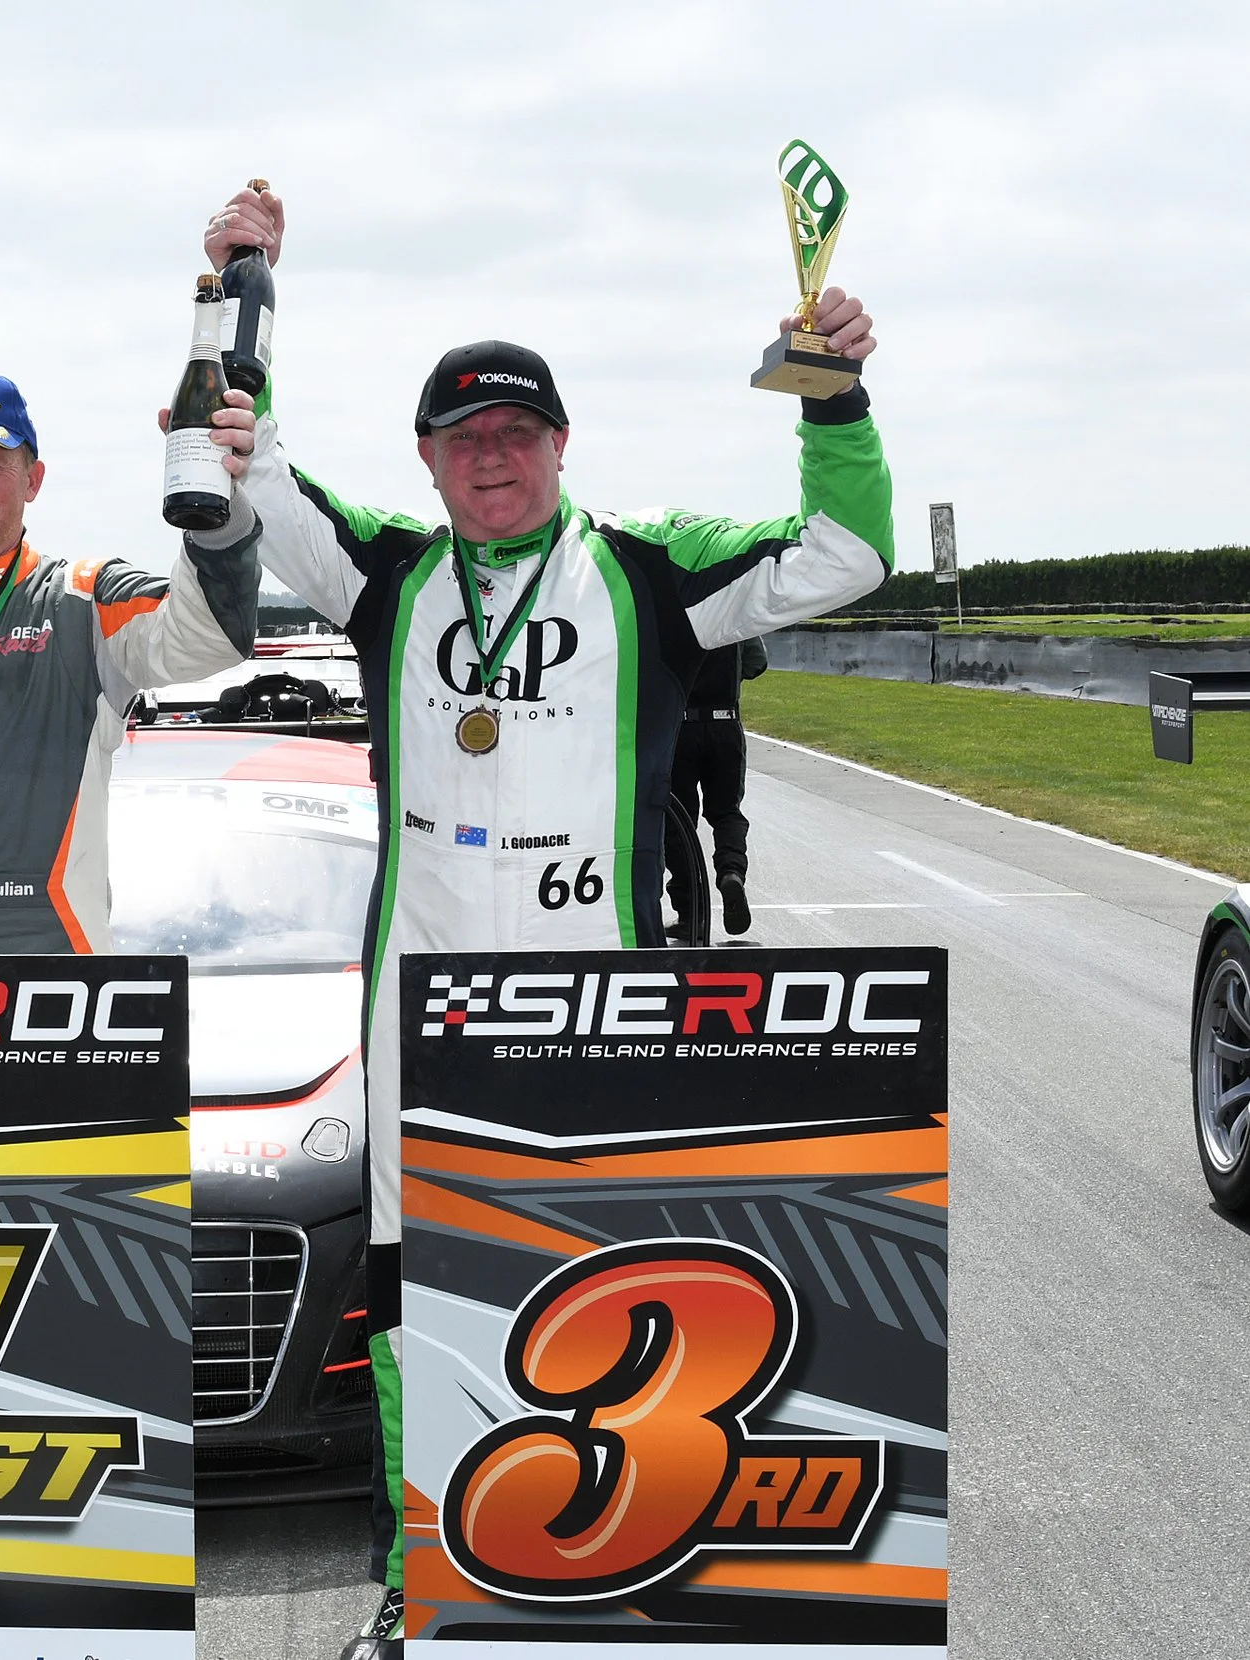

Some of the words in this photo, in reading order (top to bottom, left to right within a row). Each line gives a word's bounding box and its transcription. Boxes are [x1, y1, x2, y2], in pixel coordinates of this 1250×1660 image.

[477, 373, 539, 391] YOKOHAMA
[428, 698, 574, 721] SOLTIONS
[262, 796, 349, 817] OMP
[501, 837, 509, 850] J.
[511, 834, 571, 850] GOODACRE
[538, 856, 605, 911] 66
[462, 971, 930, 1036] SIERDC
[76, 1050, 161, 1064] SERIES
[492, 1044, 573, 1059] SOUTH
[581, 1044, 665, 1058] ISLAND
[675, 1043, 821, 1058] ENDURANCE
[830, 1042, 918, 1057] SERIES
